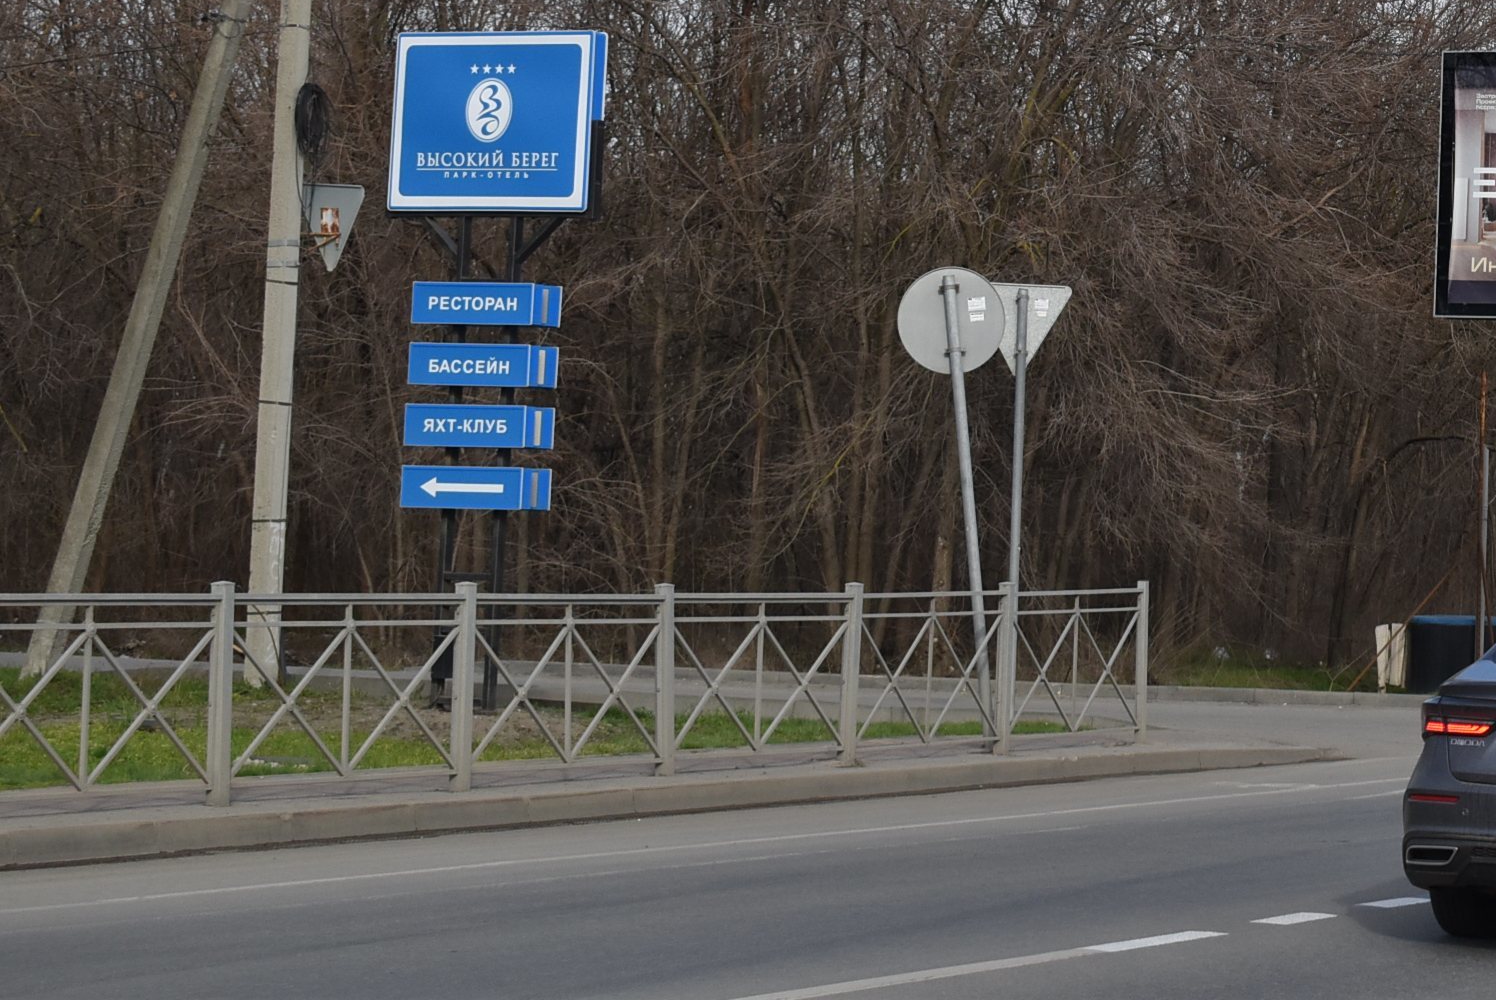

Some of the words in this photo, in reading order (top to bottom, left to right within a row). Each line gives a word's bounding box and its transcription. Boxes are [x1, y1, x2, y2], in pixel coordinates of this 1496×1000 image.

[417, 150, 504, 167] ВЫСОКИЙ
[511, 152, 560, 167] БЕРЕГ
[443, 171, 530, 179] ПАРК-ОТЕЛЬ
[428, 296, 519, 312] РЕСТОРАН
[428, 356, 511, 375] БАССЕЙН
[422, 418, 508, 434] ЯХТ-КЛУБ
